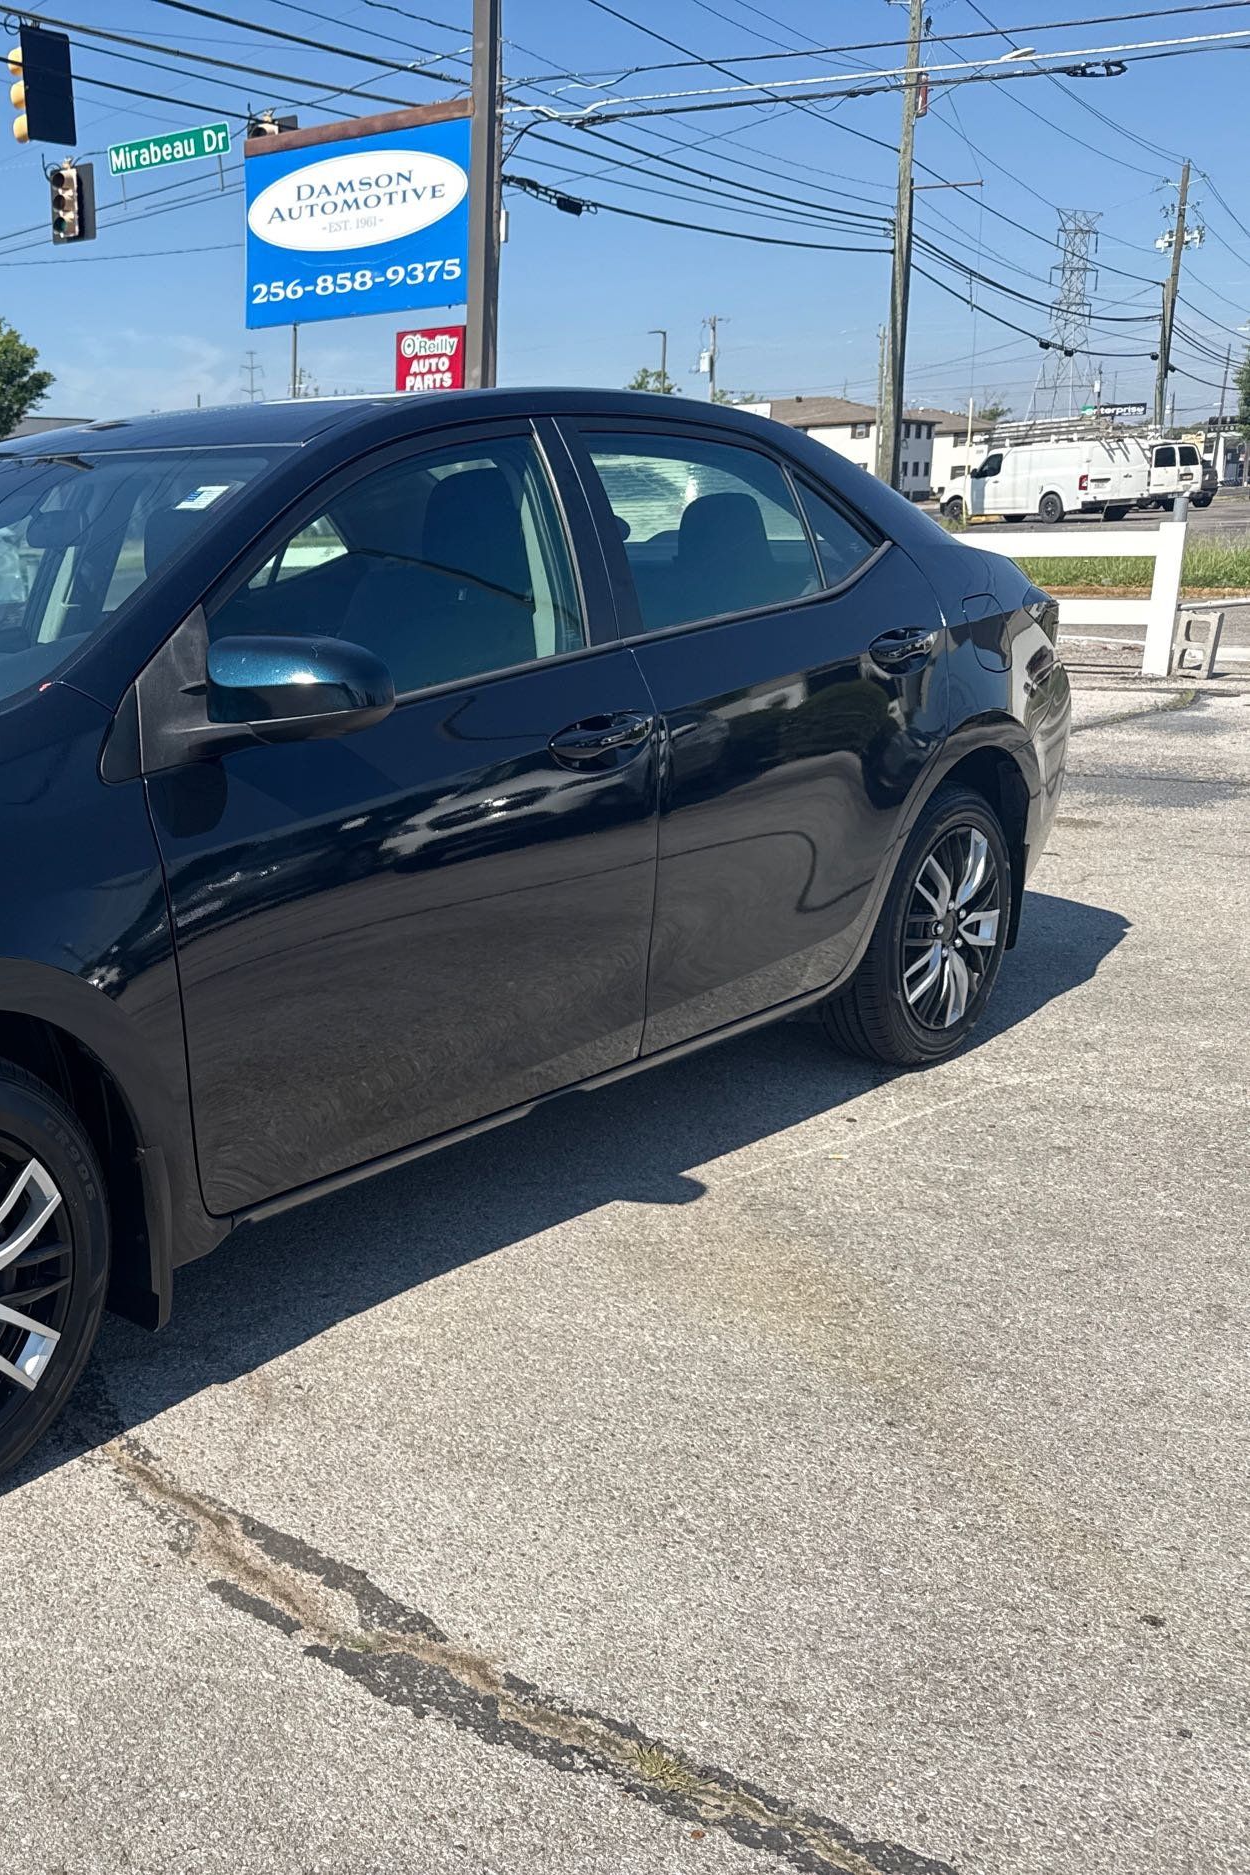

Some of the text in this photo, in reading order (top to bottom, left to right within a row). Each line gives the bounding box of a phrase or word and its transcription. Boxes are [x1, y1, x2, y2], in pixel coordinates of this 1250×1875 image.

[110, 129, 226, 172] Mirabeau Dr
[296, 169, 414, 202] DAMSON
[267, 183, 446, 225] AUTOMOTIVE
[251, 258, 462, 305] 256-858-9375
[402, 335, 456, 357] O'Reilly
[405, 372, 453, 391] PARTS
[410, 356, 449, 374] AUTO
